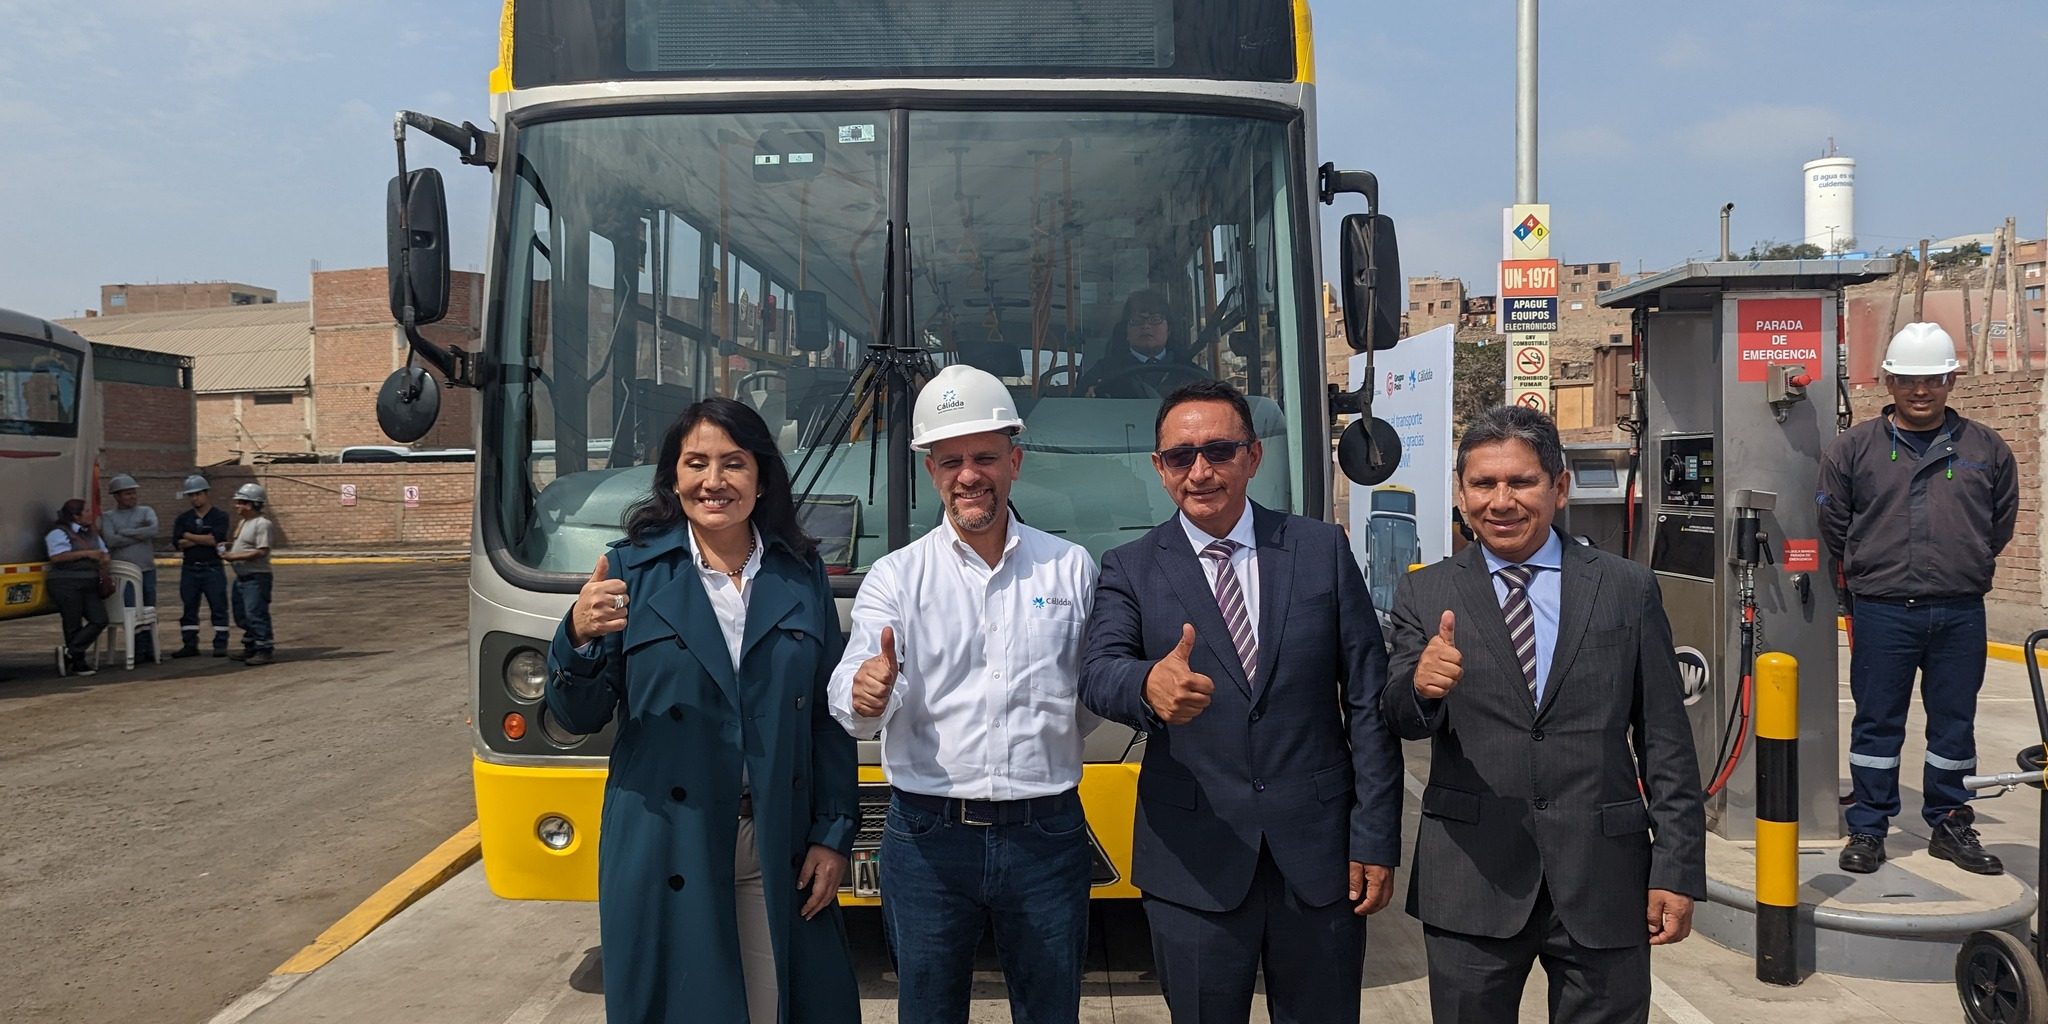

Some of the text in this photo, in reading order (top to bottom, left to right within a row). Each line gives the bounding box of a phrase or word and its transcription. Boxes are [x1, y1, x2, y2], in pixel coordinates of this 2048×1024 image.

[1527, 218, 1534, 228] 4
[1519, 227, 1543, 237] 1 0
[1504, 267, 1556, 290] UN-1971
[1513, 299, 1548, 309] APAGUE
[1511, 311, 1550, 321] EQUIPOS
[1504, 321, 1557, 331] ELECTRÓNICOS
[1756, 320, 1803, 331] PARADA
[1771, 335, 1788, 345] DE
[1743, 349, 1817, 360] EMERGENCIA
